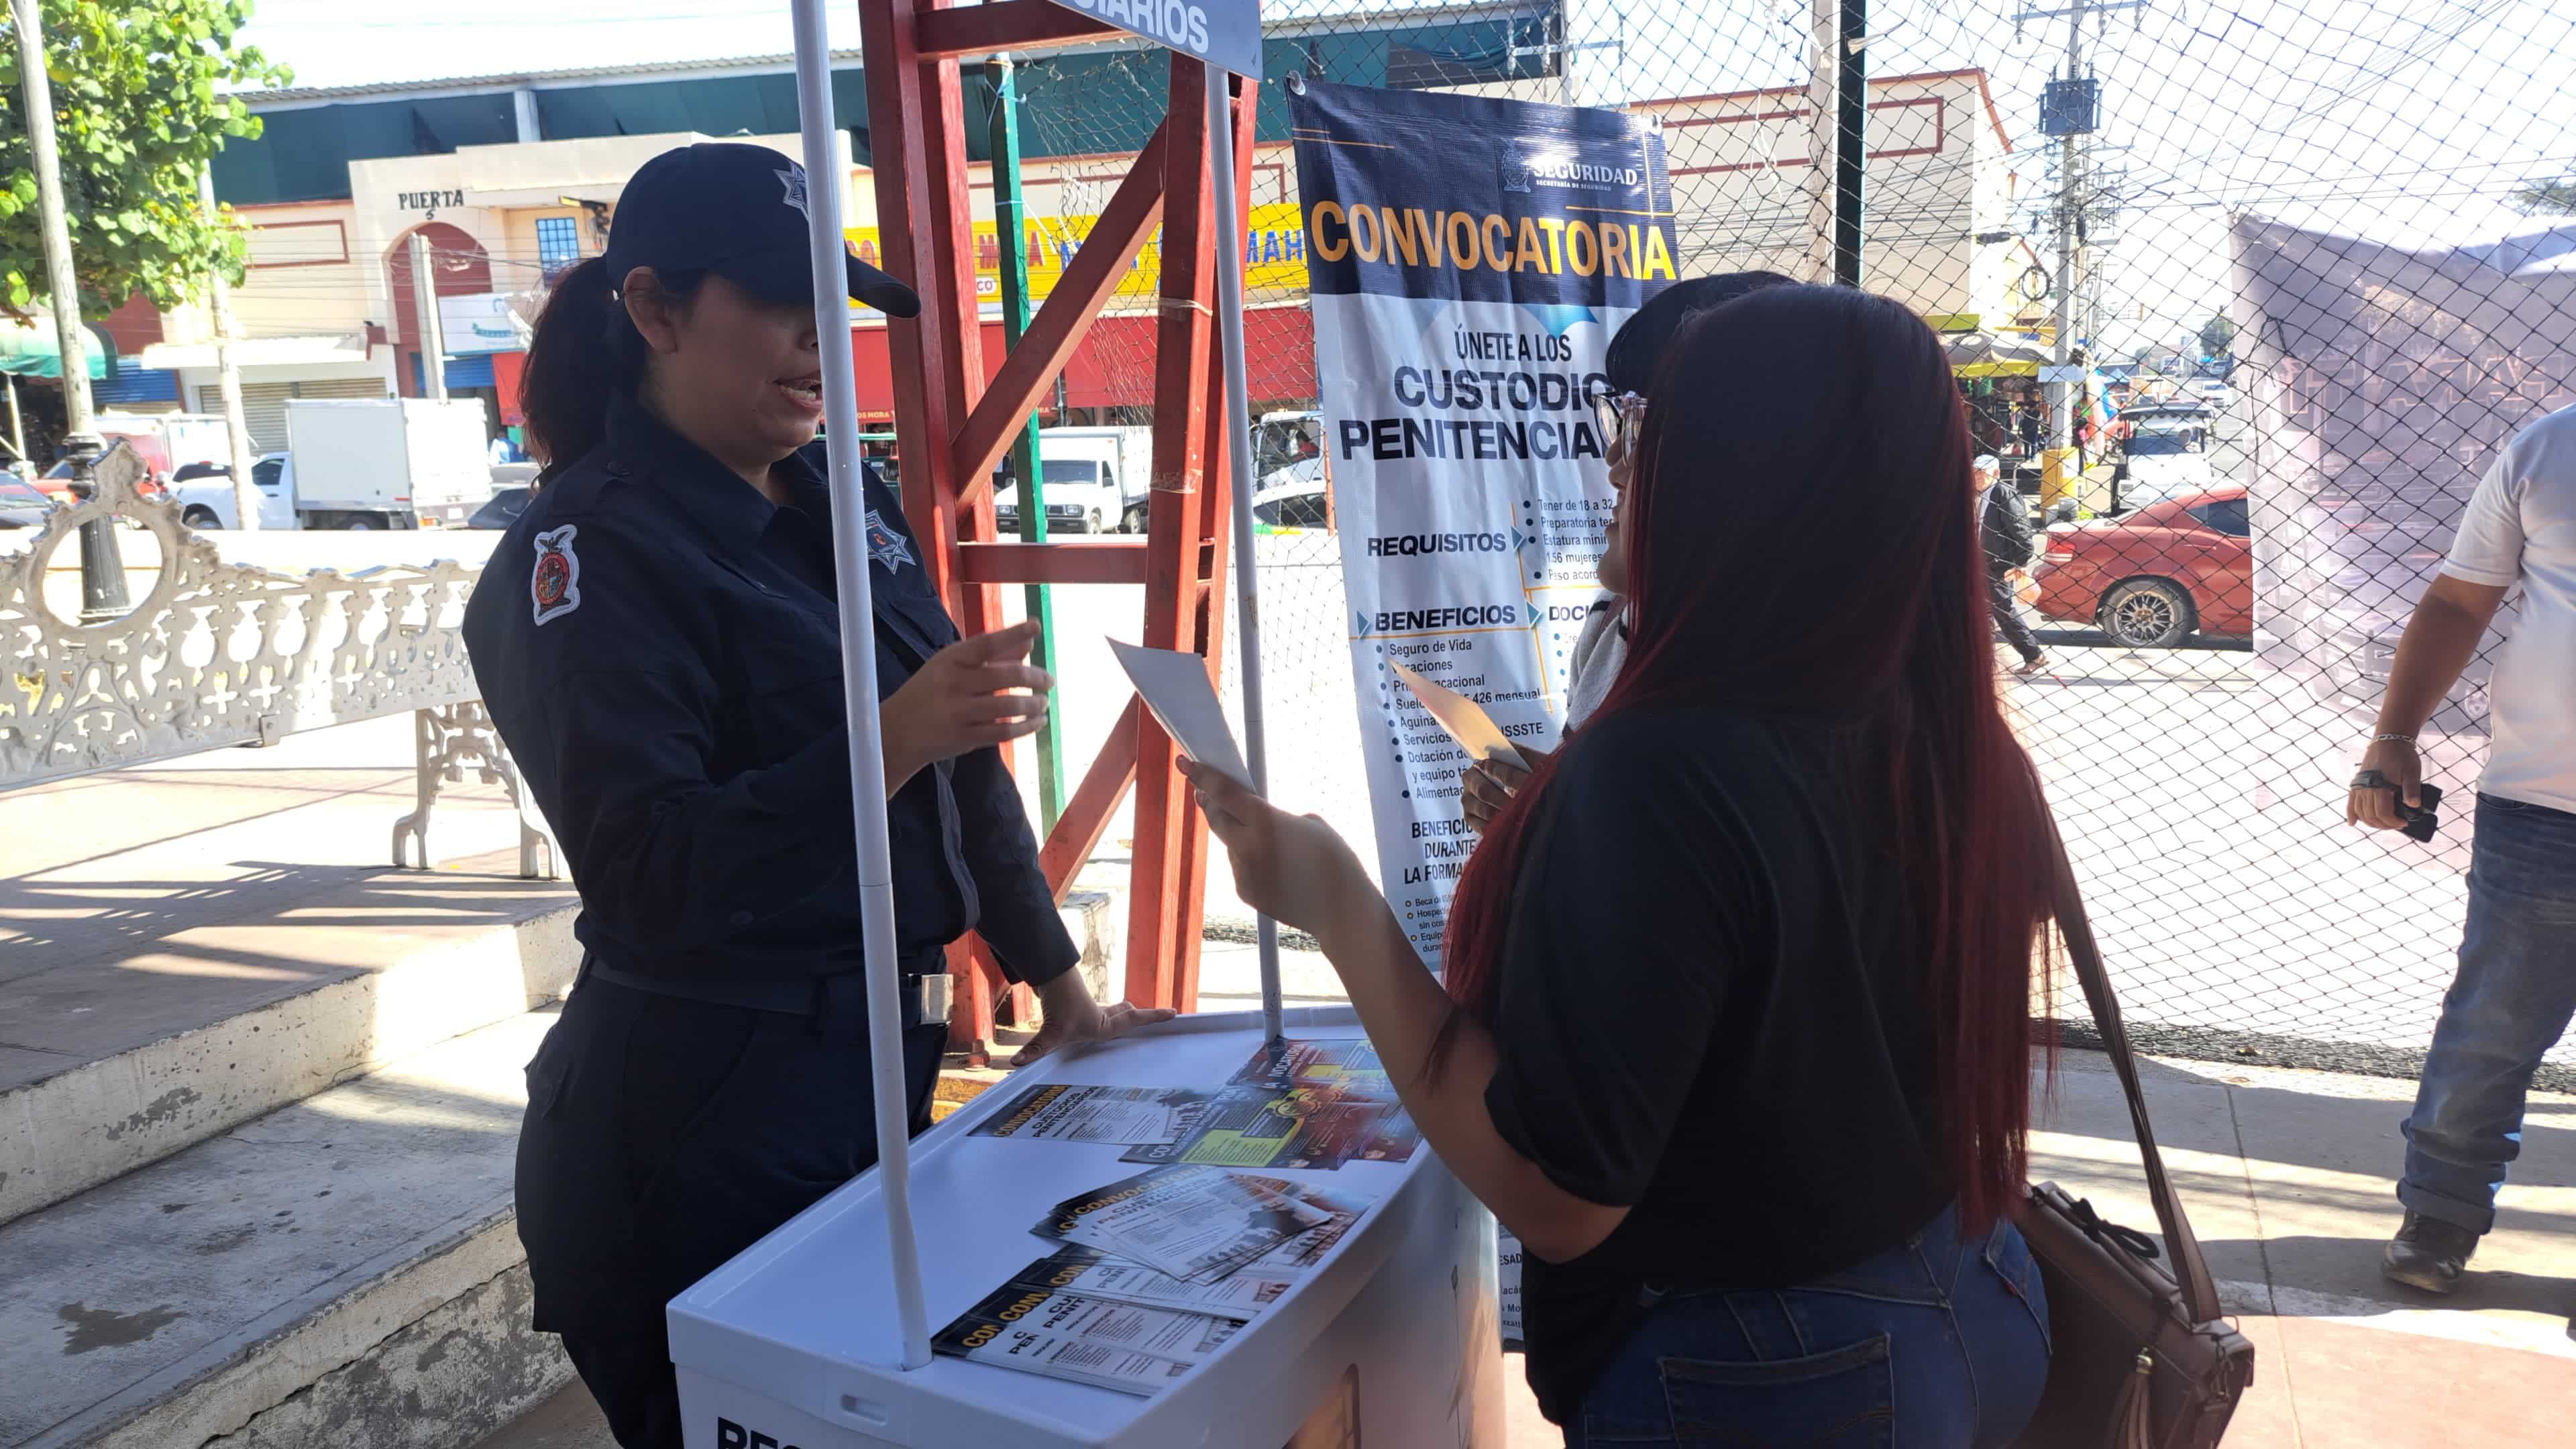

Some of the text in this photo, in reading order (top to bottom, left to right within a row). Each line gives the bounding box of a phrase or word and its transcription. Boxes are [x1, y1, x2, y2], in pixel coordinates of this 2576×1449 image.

[1534, 161, 1638, 185] SEGURIDAD
[398, 189, 464, 210] PUERTA
[1311, 201, 1677, 280] CONVOCATORIA
[1456, 323, 1572, 362] ÚNETE A LOS
[1339, 419, 1606, 461] PENITENCIA
[1538, 498, 1613, 511] Tener de 18 a 32
[1541, 516, 1597, 531] Preparatoria
[1368, 533, 1506, 557] REQUISITOS
[1543, 534, 1580, 546] Estatura
[1375, 605, 1515, 631] BENEFICIOS
[1390, 639, 1472, 658] Seguro de Vida
[1495, 688, 1540, 702] mensual
[1400, 715, 1439, 731] Aguina
[1403, 732, 1452, 746] Servicios
[1408, 749, 1453, 763] Dotación
[1413, 772, 1417, 784] y
[1420, 768, 1455, 783] equipo
[1424, 839, 1477, 859] DURANTE
[1404, 866, 1421, 884] LA
